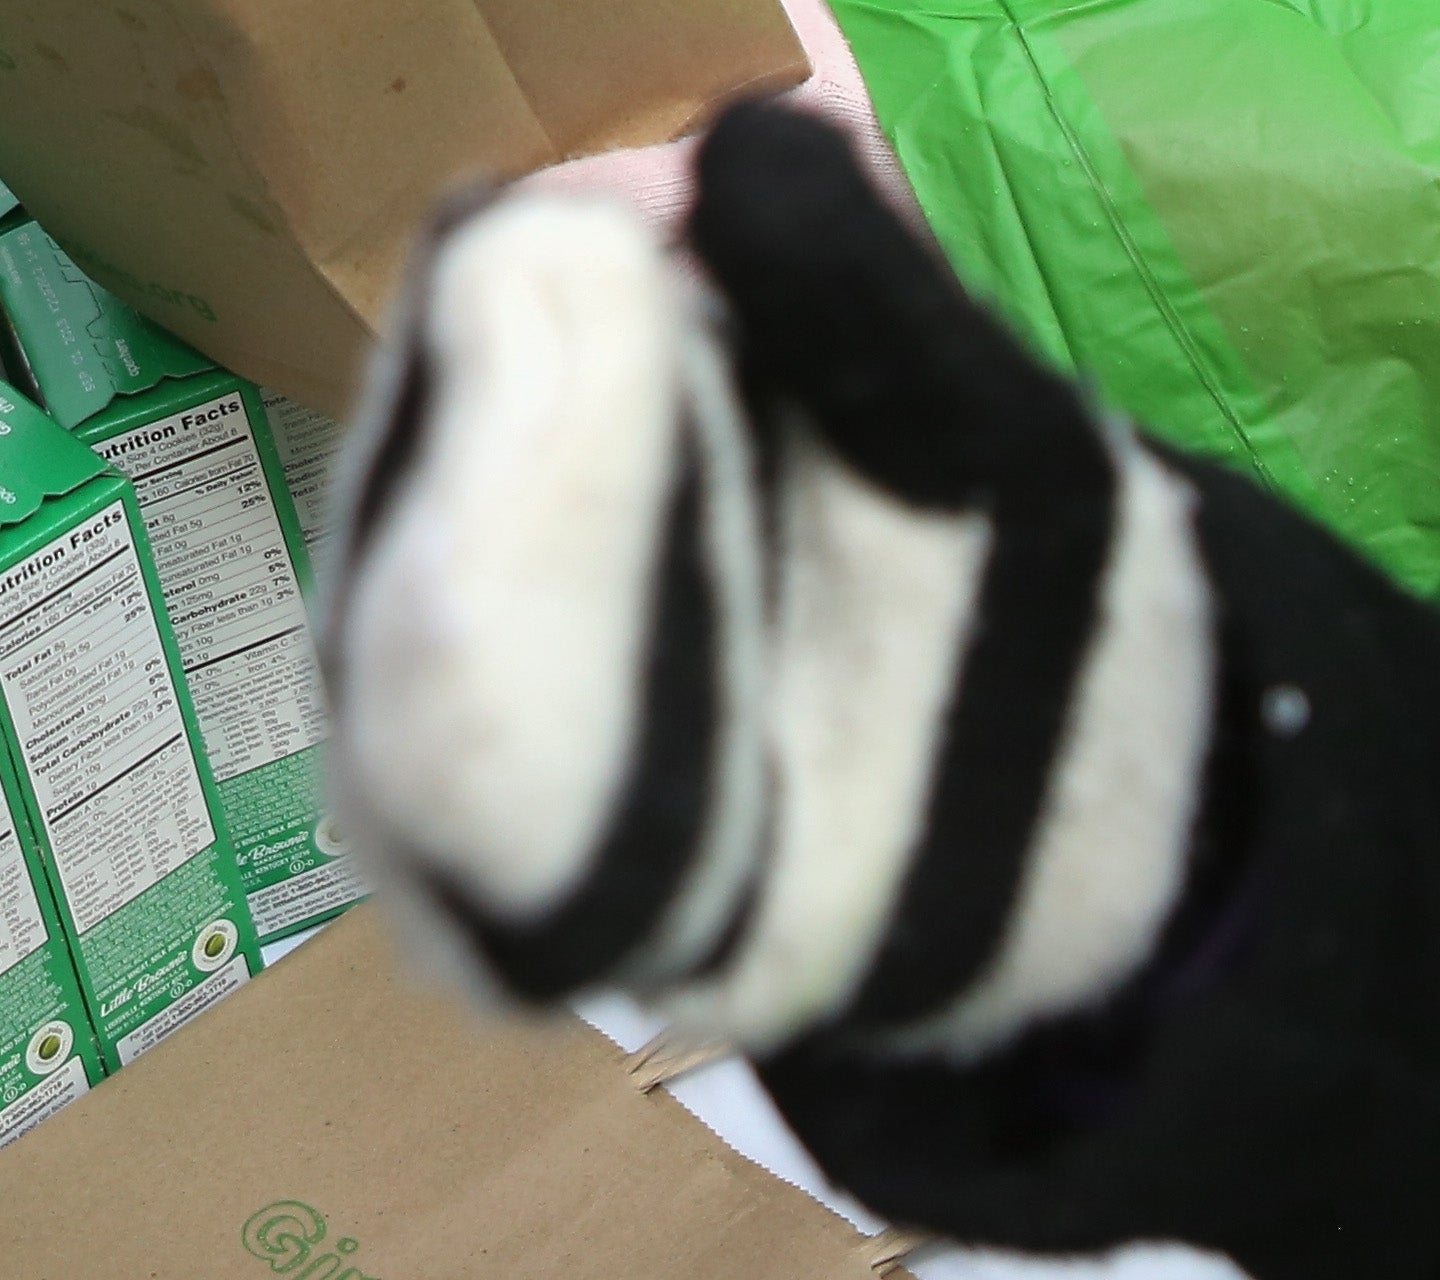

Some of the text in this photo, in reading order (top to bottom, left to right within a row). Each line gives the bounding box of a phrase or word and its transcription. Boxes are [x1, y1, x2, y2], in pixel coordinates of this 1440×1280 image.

[97, 398, 241, 462] utrition Facts
[69, 505, 122, 551] Facts
[19, 576, 40, 596] Size
[40, 571, 48, 583] 4
[48, 548, 85, 578] Cookies
[84, 533, 109, 557] (32g)
[30, 583, 48, 602] Per
[47, 559, 88, 591] Container
[87, 542, 114, 565] About
[113, 537, 121, 549] 8
[43, 610, 61, 628] 160
[63, 589, 94, 615] Calories
[94, 577, 112, 595] from
[112, 568, 125, 583] Fat
[124, 561, 136, 575] 70
[4, 587, 143, 683] Total Fat 8g 12%
[18, 602, 147, 691] Saturated Fat 5g 25%
[24, 654, 162, 752] Cholesterol 0mg 0%
[28, 668, 165, 765] Sodium 125mg 5%
[33, 682, 169, 778] Total Carbohydrate 22g 7%
[45, 777, 98, 819] Protein 1g
